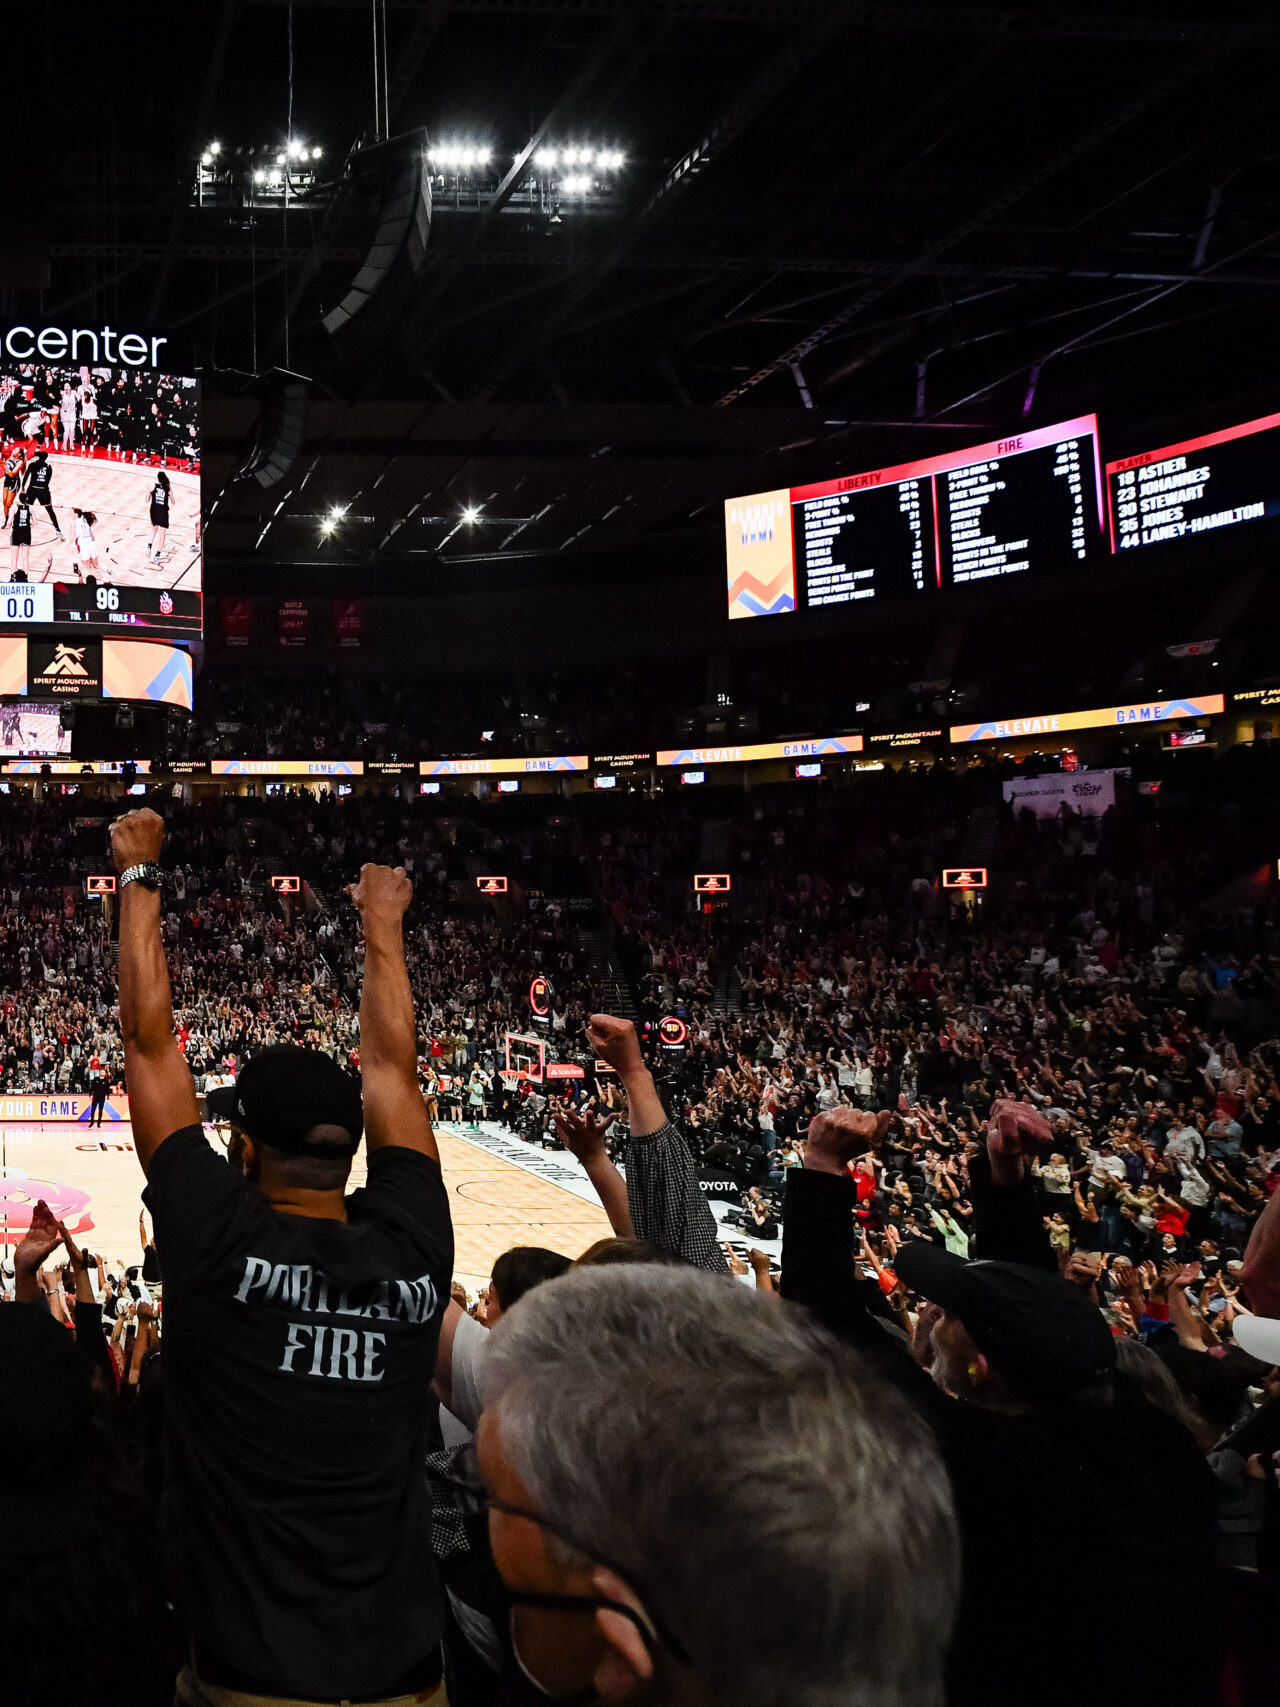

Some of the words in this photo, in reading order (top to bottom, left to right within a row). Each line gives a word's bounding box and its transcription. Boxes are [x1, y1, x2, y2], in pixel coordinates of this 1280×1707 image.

[997, 437, 1023, 455] FIRE
[1116, 454, 1151, 470] PLAYER
[1117, 470, 1135, 487] 18
[1137, 456, 1187, 482] ASTIER
[838, 473, 881, 491] LIBERTY
[1117, 486, 1136, 504] 23
[1139, 466, 1211, 498] JOHANNES
[1118, 501, 1137, 519] 30
[1140, 484, 1206, 513] STEWART
[1119, 517, 1139, 534] 35
[1141, 506, 1184, 529] JONES
[1120, 533, 1140, 549] 44
[1142, 502, 1265, 545] LANEY-HAMILTON
[0, 586, 36, 597] QUARTER
[96, 588, 119, 610] 96
[7, 598, 34, 618] 0.0
[69, 611, 82, 621] TOL
[108, 613, 128, 624] FOULS
[33, 677, 55, 685] SPIRIT
[56, 678, 98, 686] MOUNTAIN
[52, 685, 80, 693] CASINO
[1233, 690, 1267, 701] SPIRIT
[1260, 697, 1280, 705] CAS
[995, 716, 1060, 738] ELEVATE
[1116, 705, 1162, 724] GAME
[869, 734, 894, 743] SPIRIT
[895, 730, 941, 740] MOUNTAIN
[889, 738, 921, 747] CASINO
[614, 753, 650, 761] MOUNTAIN
[691, 748, 742, 762] ELEVATE
[783, 743, 817, 756] GAME
[239, 762, 278, 774] ELEVATE
[308, 763, 333, 774] GAME
[450, 760, 492, 774] ELEVATE
[525, 760, 552, 771] GAME
[40, 1100, 78, 1117] GAME
[74, 1142, 134, 1152] chi
[699, 1179, 738, 1192] OYOTA
[232, 1256, 438, 1324] PORTLAND
[277, 1322, 387, 1382] FIRE
